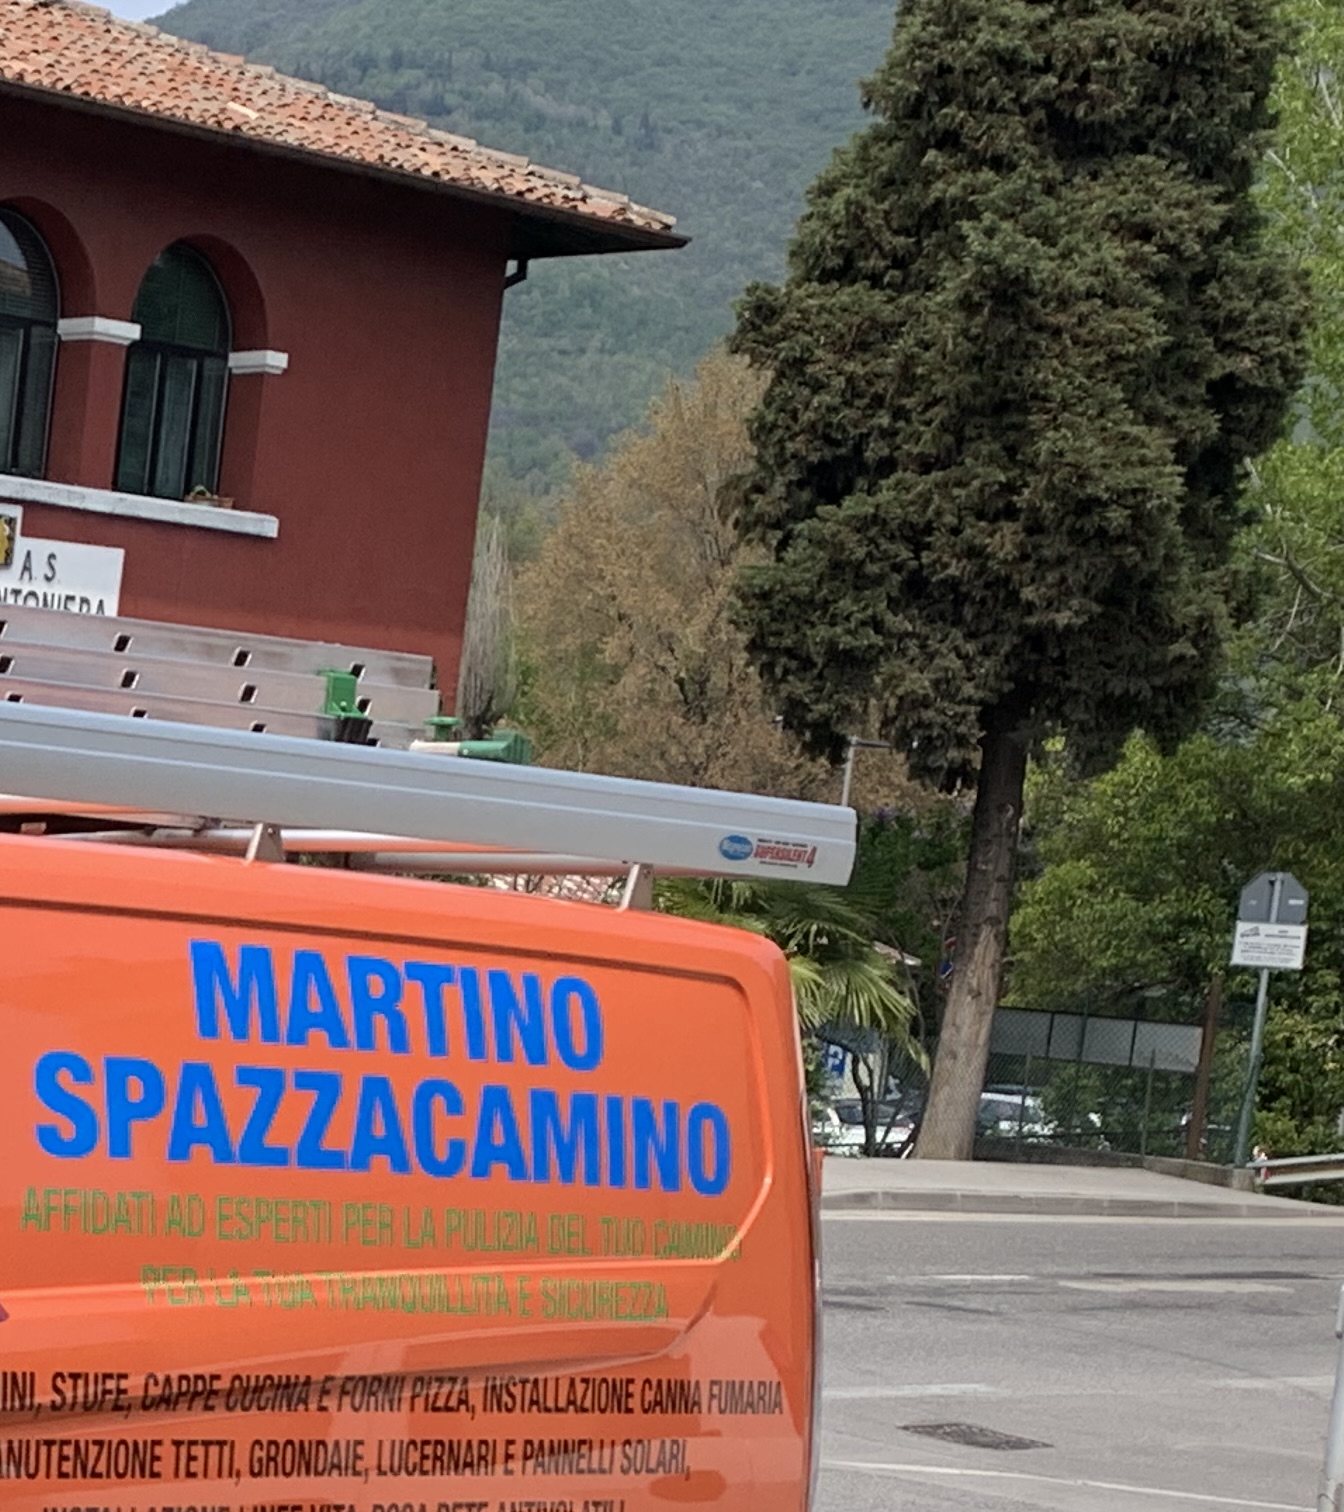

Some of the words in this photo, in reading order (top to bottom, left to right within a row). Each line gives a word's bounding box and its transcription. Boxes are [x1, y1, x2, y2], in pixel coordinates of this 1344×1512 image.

[190, 939, 605, 1072] MARTINO
[34, 1051, 732, 1197] SPAZZACAMINO
[20, 1186, 155, 1236] AFFIDATI
[164, 1193, 205, 1238] AD
[215, 1195, 332, 1244] ESPERTI
[341, 1201, 394, 1247] PER
[403, 1206, 436, 1248] LA
[445, 1208, 539, 1254] PULIZIA
[547, 1213, 592, 1256] DEL
[600, 1217, 644, 1257] TUO
[140, 1264, 205, 1305] PER
[207, 1267, 253, 1307] LA
[252, 1268, 316, 1310] TUA
[516, 1276, 532, 1318] E
[539, 1277, 669, 1322] SICUREZZA
[49, 1371, 132, 1419] STUFE,
[140, 1372, 221, 1412] CAPPE
[225, 1373, 312, 1413] CUCINA
[316, 1375, 335, 1412] E
[336, 1375, 407, 1413] FORNI
[409, 1375, 476, 1421] PIZZA,
[482, 1375, 635, 1415] INSTALLAZIONE
[640, 1377, 703, 1415] CANNA
[706, 1379, 785, 1416] FUMARIA
[170, 1438, 241, 1485] TETTI,
[249, 1438, 369, 1484] GRONDAIE,
[376, 1438, 496, 1477] LUCERNARI
[502, 1439, 516, 1476] E
[520, 1439, 616, 1476] PANNELLI
[620, 1438, 691, 1481] SOLARI,
